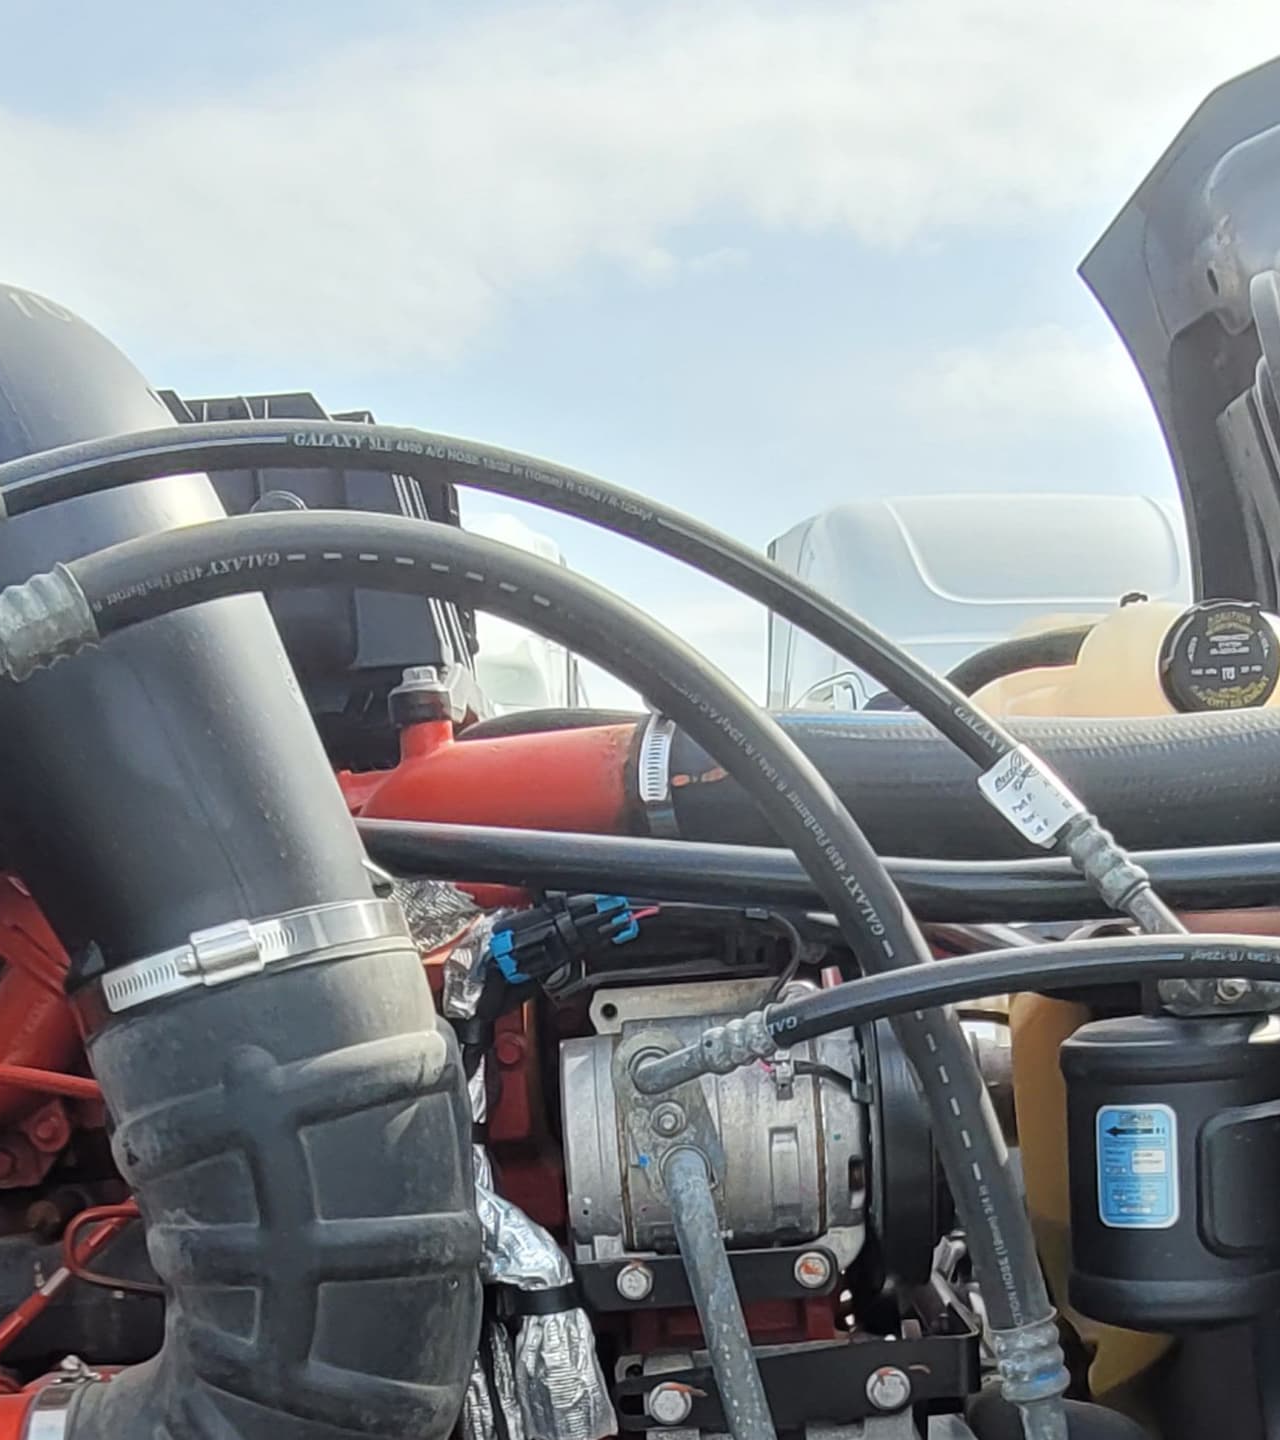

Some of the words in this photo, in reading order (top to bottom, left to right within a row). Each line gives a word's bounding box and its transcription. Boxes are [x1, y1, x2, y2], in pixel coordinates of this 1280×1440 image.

[293, 432, 363, 449] GALAXY
[207, 551, 281, 575] GALAXY
[841, 872, 885, 937] GALAXY
[767, 1015, 798, 1037] GAL
[1007, 1291, 1024, 1326] CTION
